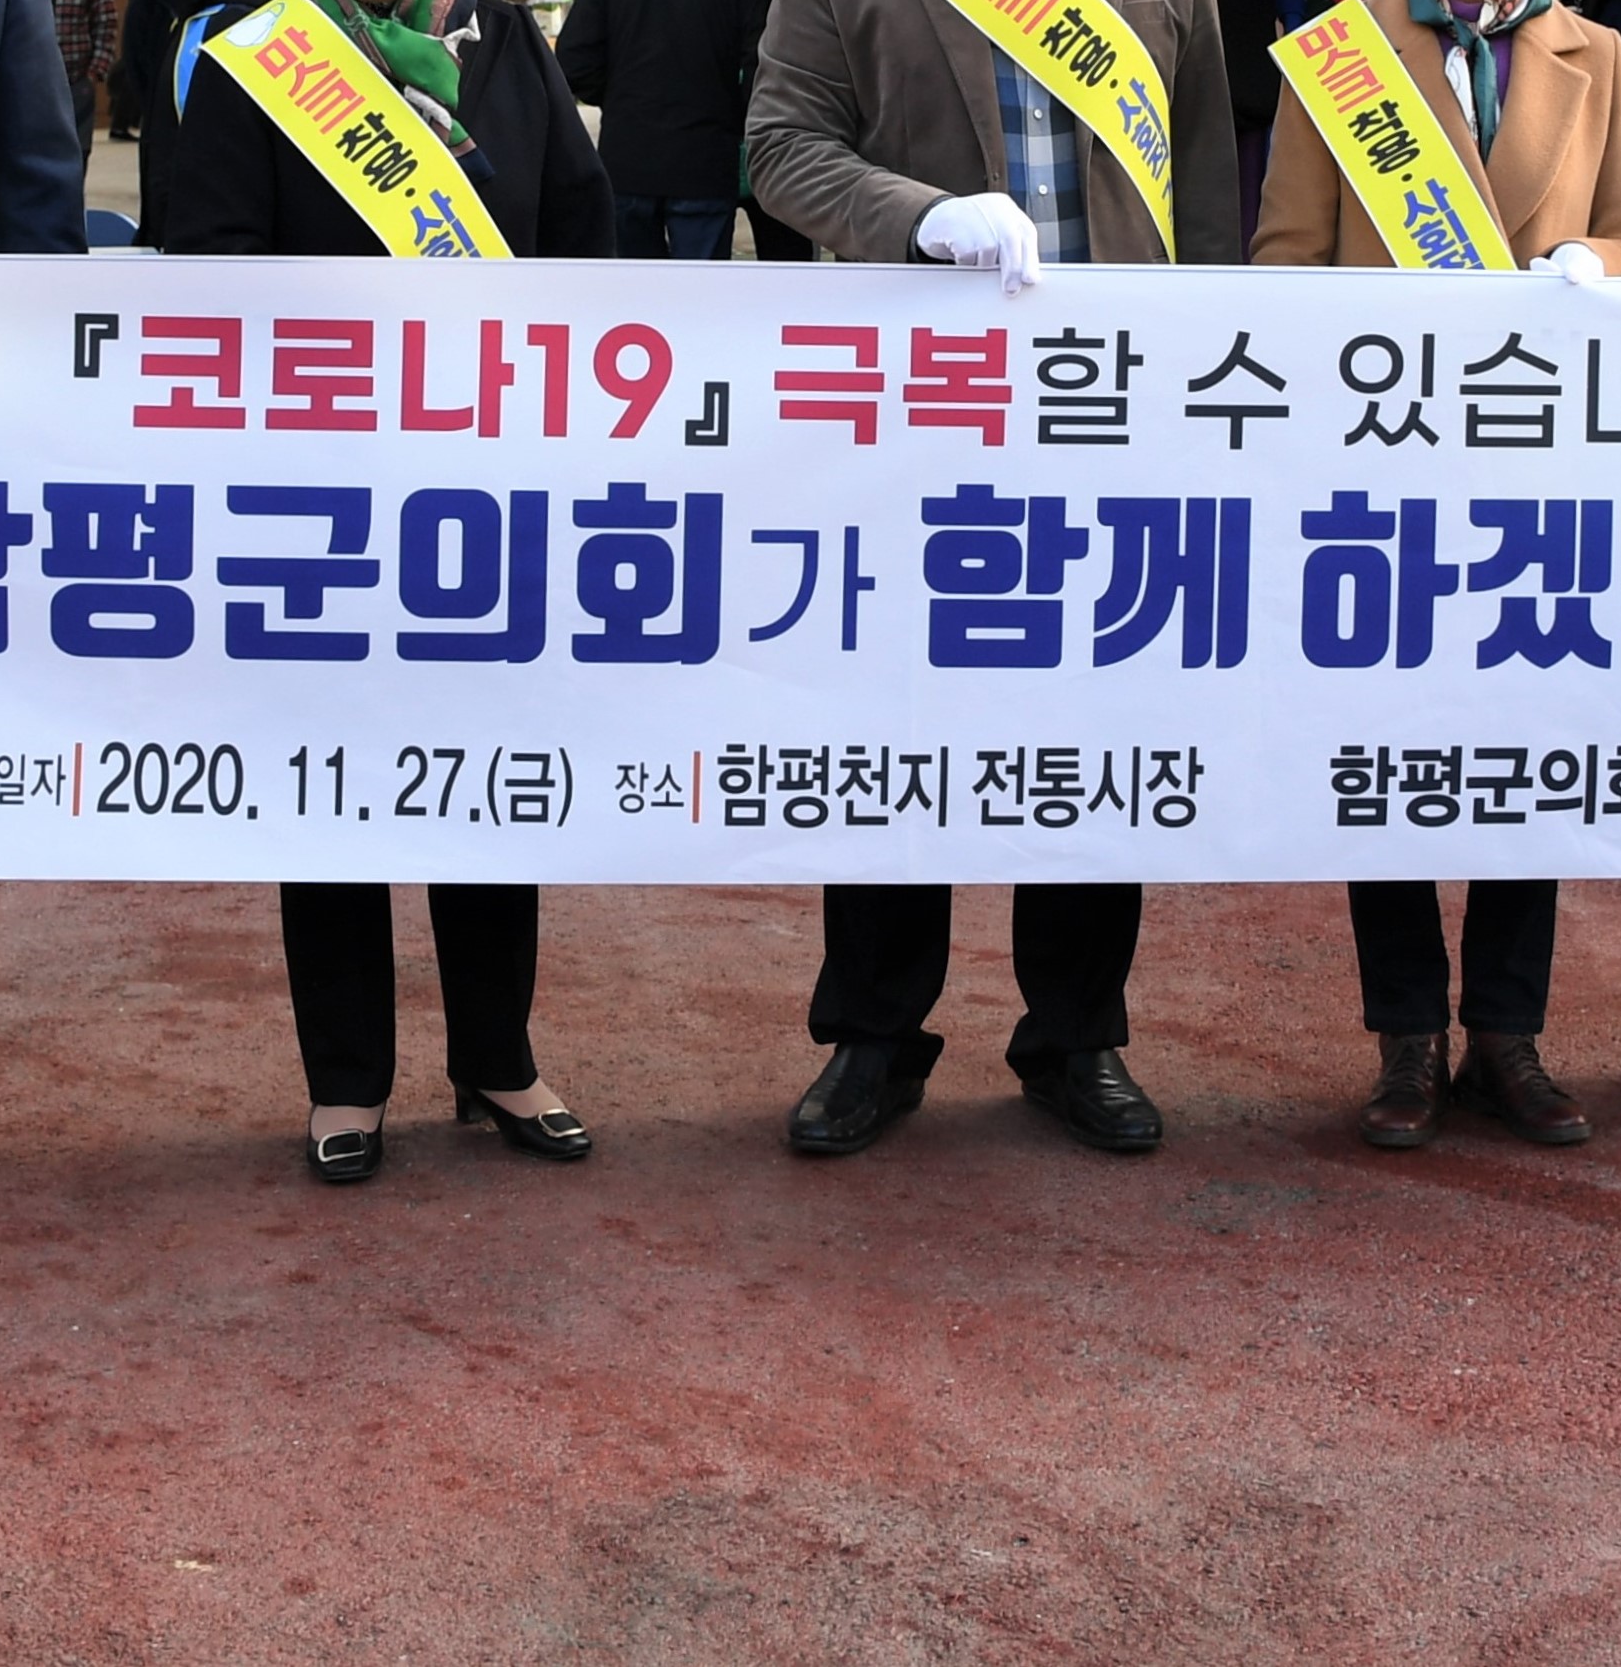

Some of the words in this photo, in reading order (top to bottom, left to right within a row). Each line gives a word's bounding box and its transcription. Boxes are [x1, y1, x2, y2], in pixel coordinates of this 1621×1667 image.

[254, 26, 366, 135] 마스크
[334, 111, 419, 194] 착용
[1039, 6, 1117, 88] 착용
[1294, 17, 1386, 115] 마스크
[1347, 99, 1421, 175] 착용
[773, 324, 1144, 447] 극복할
[1184, 330, 1290, 451] 수
[920, 483, 1252, 670] 함께
[96, 741, 258, 821] 2020.
[288, 745, 370, 821] 11.
[613, 761, 684, 814] 장소
[717, 743, 949, 829] 함평천지
[971, 746, 1205, 829] 전통시장
